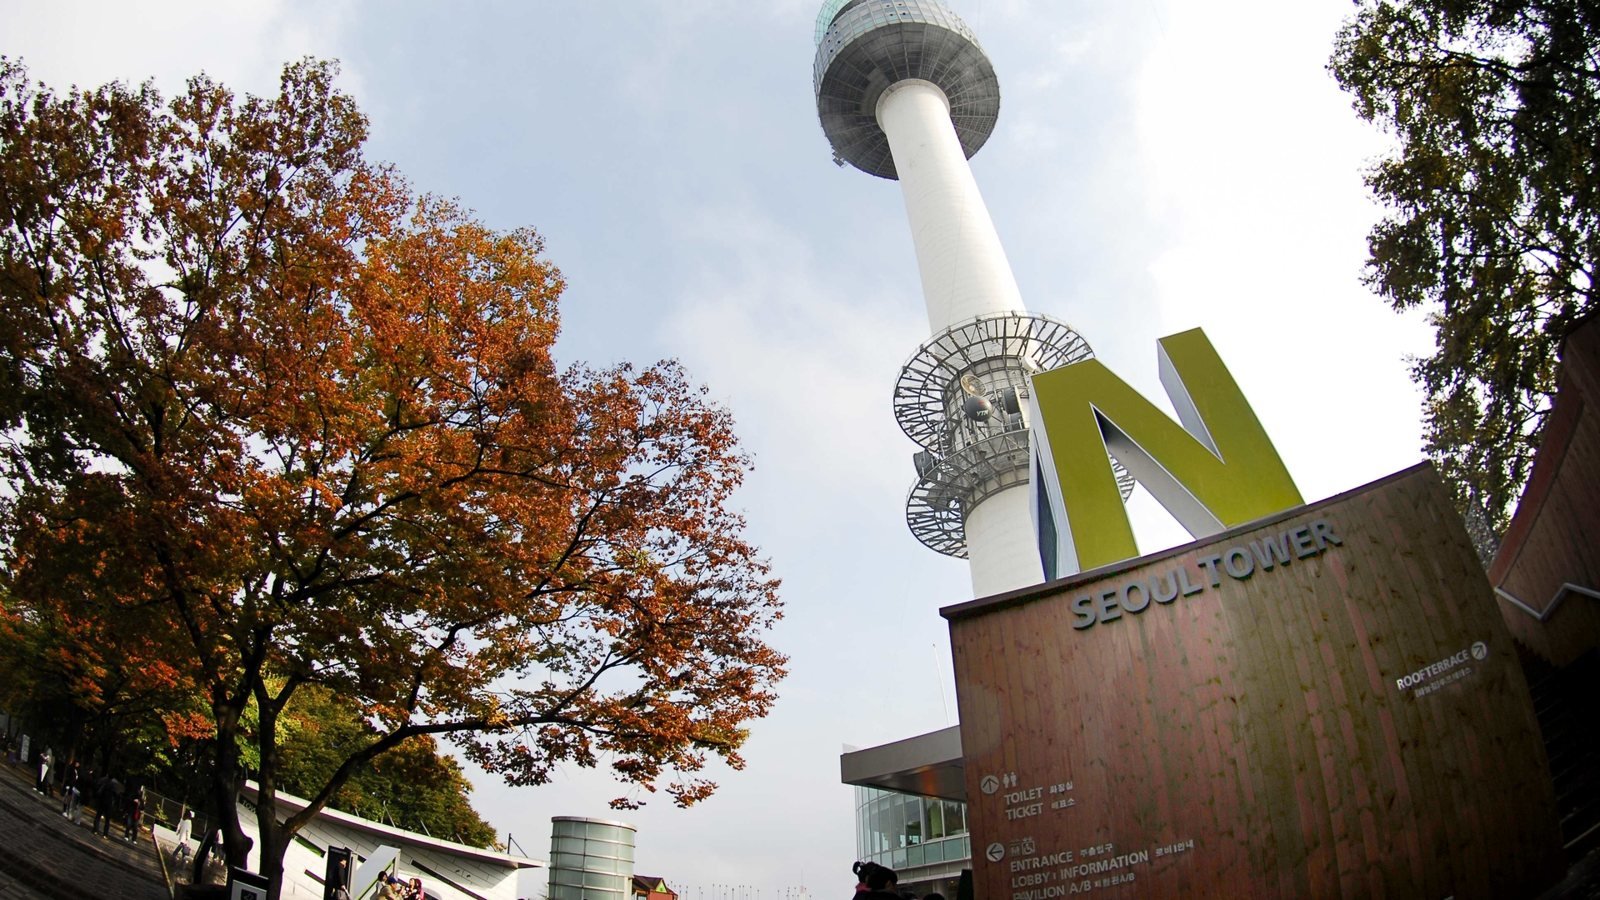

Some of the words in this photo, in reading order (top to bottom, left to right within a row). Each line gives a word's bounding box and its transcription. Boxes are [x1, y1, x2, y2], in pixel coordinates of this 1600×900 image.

[976, 409, 989, 417] YTN
[1030, 326, 1307, 573] N
[1070, 565, 1204, 631] SEOUL
[1197, 517, 1343, 589] TOWER
[1396, 649, 1471, 691] ROOFTERRACE
[1004, 786, 1044, 806] TOILET
[1006, 802, 1044, 821] TICKET
[1010, 851, 1073, 873] ENTRANCE
[1011, 871, 1051, 889] LOBBY
[1059, 850, 1149, 880] INFORMATION
[1012, 885, 1065, 900] PAVILION
[1069, 879, 1092, 894] A/B
